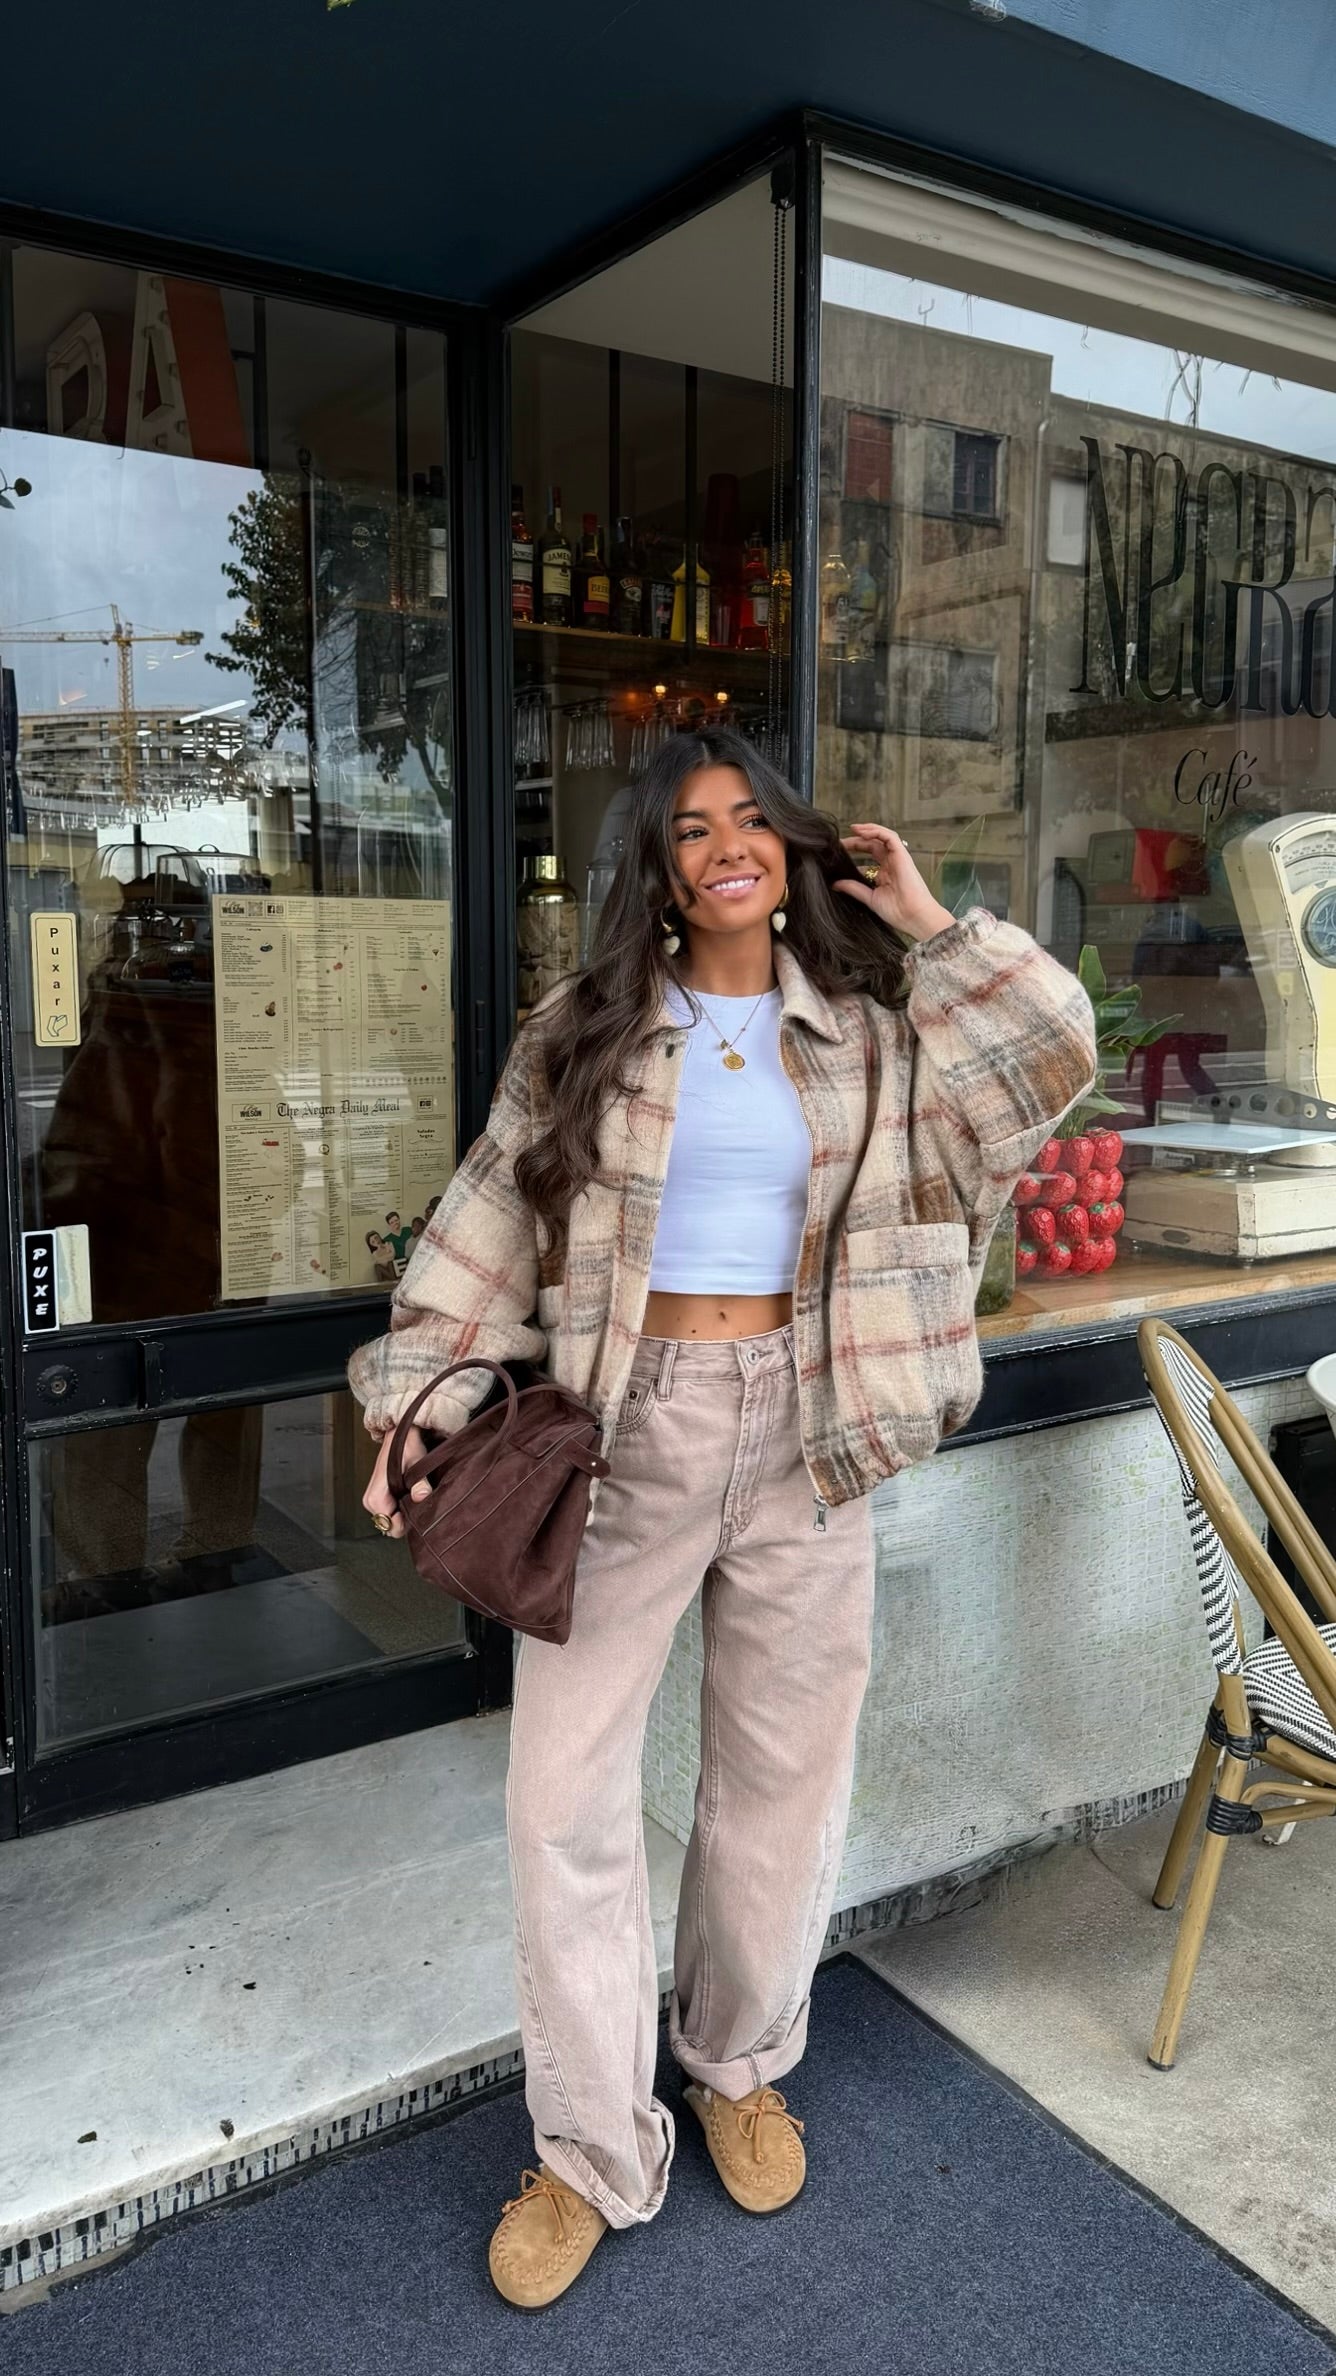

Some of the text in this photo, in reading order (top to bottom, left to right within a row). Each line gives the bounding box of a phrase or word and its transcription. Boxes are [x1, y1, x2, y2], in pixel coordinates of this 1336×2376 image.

[1174, 748, 1258, 823] Café
[50, 927, 61, 1006] Puxar
[240, 1109, 262, 1118] WILSON
[276, 1098, 400, 1120] The Negra Daily Meal
[32, 1248, 49, 1315] PUXE
